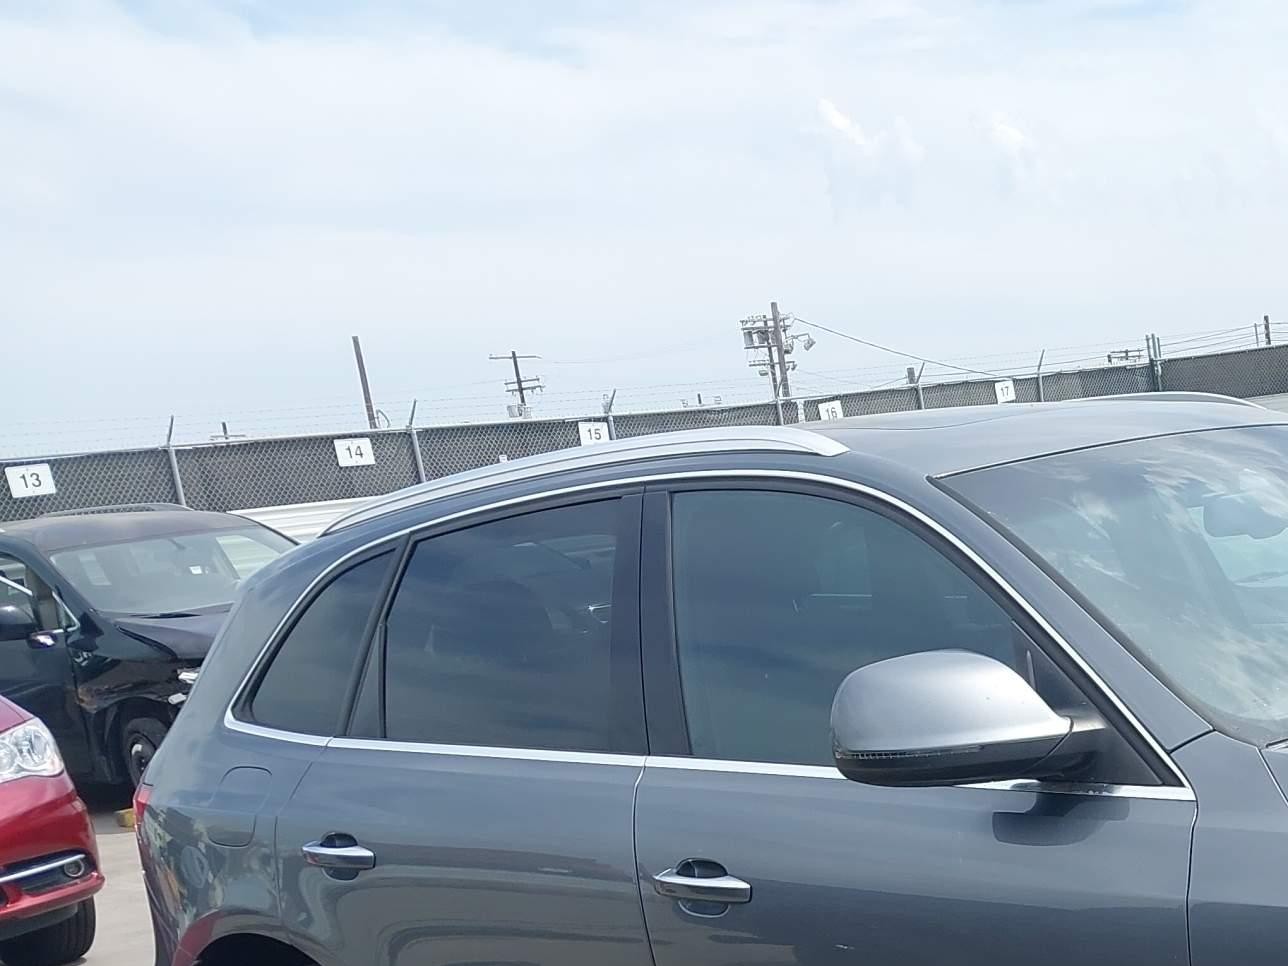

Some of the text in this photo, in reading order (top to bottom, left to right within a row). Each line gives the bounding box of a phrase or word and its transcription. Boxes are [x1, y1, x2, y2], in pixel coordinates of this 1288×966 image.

[1000, 386, 1009, 397] 17
[825, 406, 838, 420] 16
[588, 428, 602, 440] 15
[345, 445, 364, 459] 14
[19, 472, 42, 489] 13
